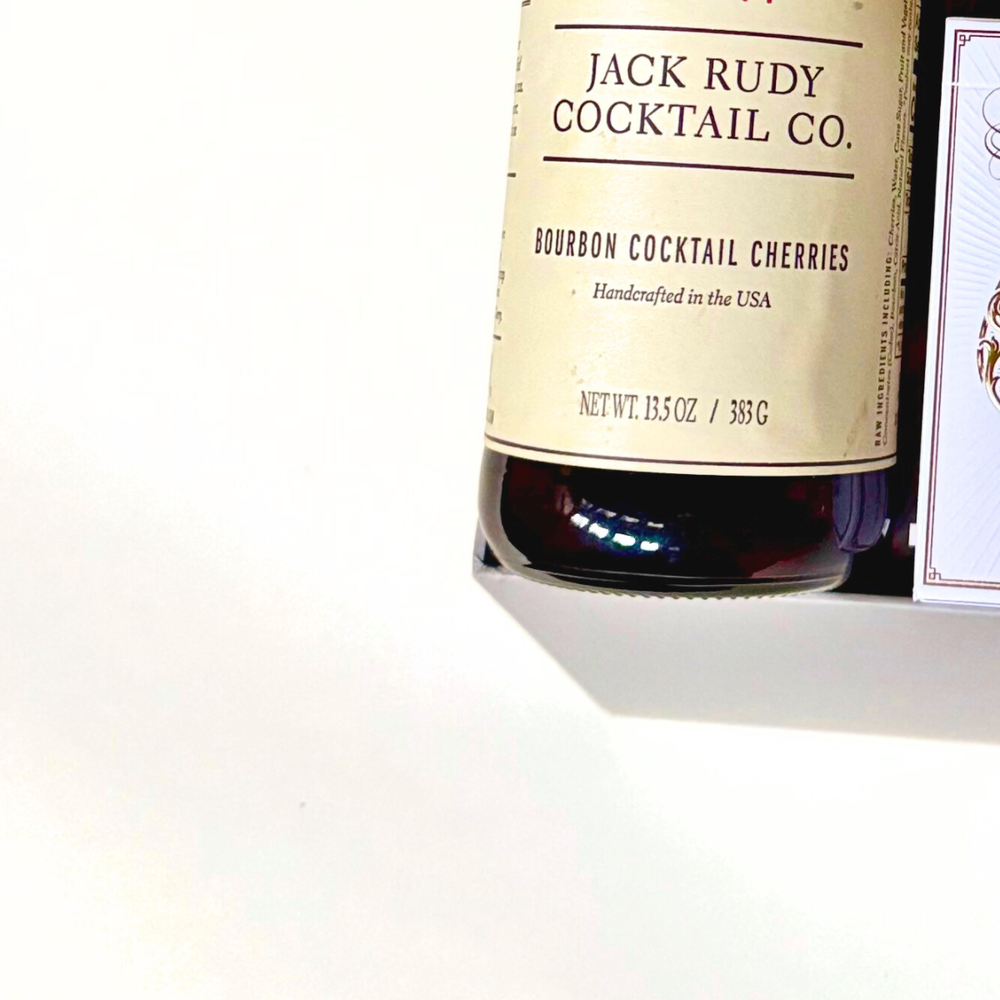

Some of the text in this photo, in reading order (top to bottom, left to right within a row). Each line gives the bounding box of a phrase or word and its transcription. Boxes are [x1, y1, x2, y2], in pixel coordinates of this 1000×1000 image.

[586, 53, 825, 98] JACK RUDY
[552, 98, 853, 150] COCKTAIL CO.
[893, 124, 901, 154] Cane
[891, 157, 900, 193] Water,
[534, 227, 850, 272] BOURBON COCKTAIL CHERRIES
[592, 282, 772, 309] Handcrafted in the USA
[881, 252, 893, 326] INCLUDING:
[876, 331, 889, 415] INGREDIENTS
[578, 390, 769, 426] NET WT. 13.5 OZ / 383 G
[874, 421, 883, 447] RAW
